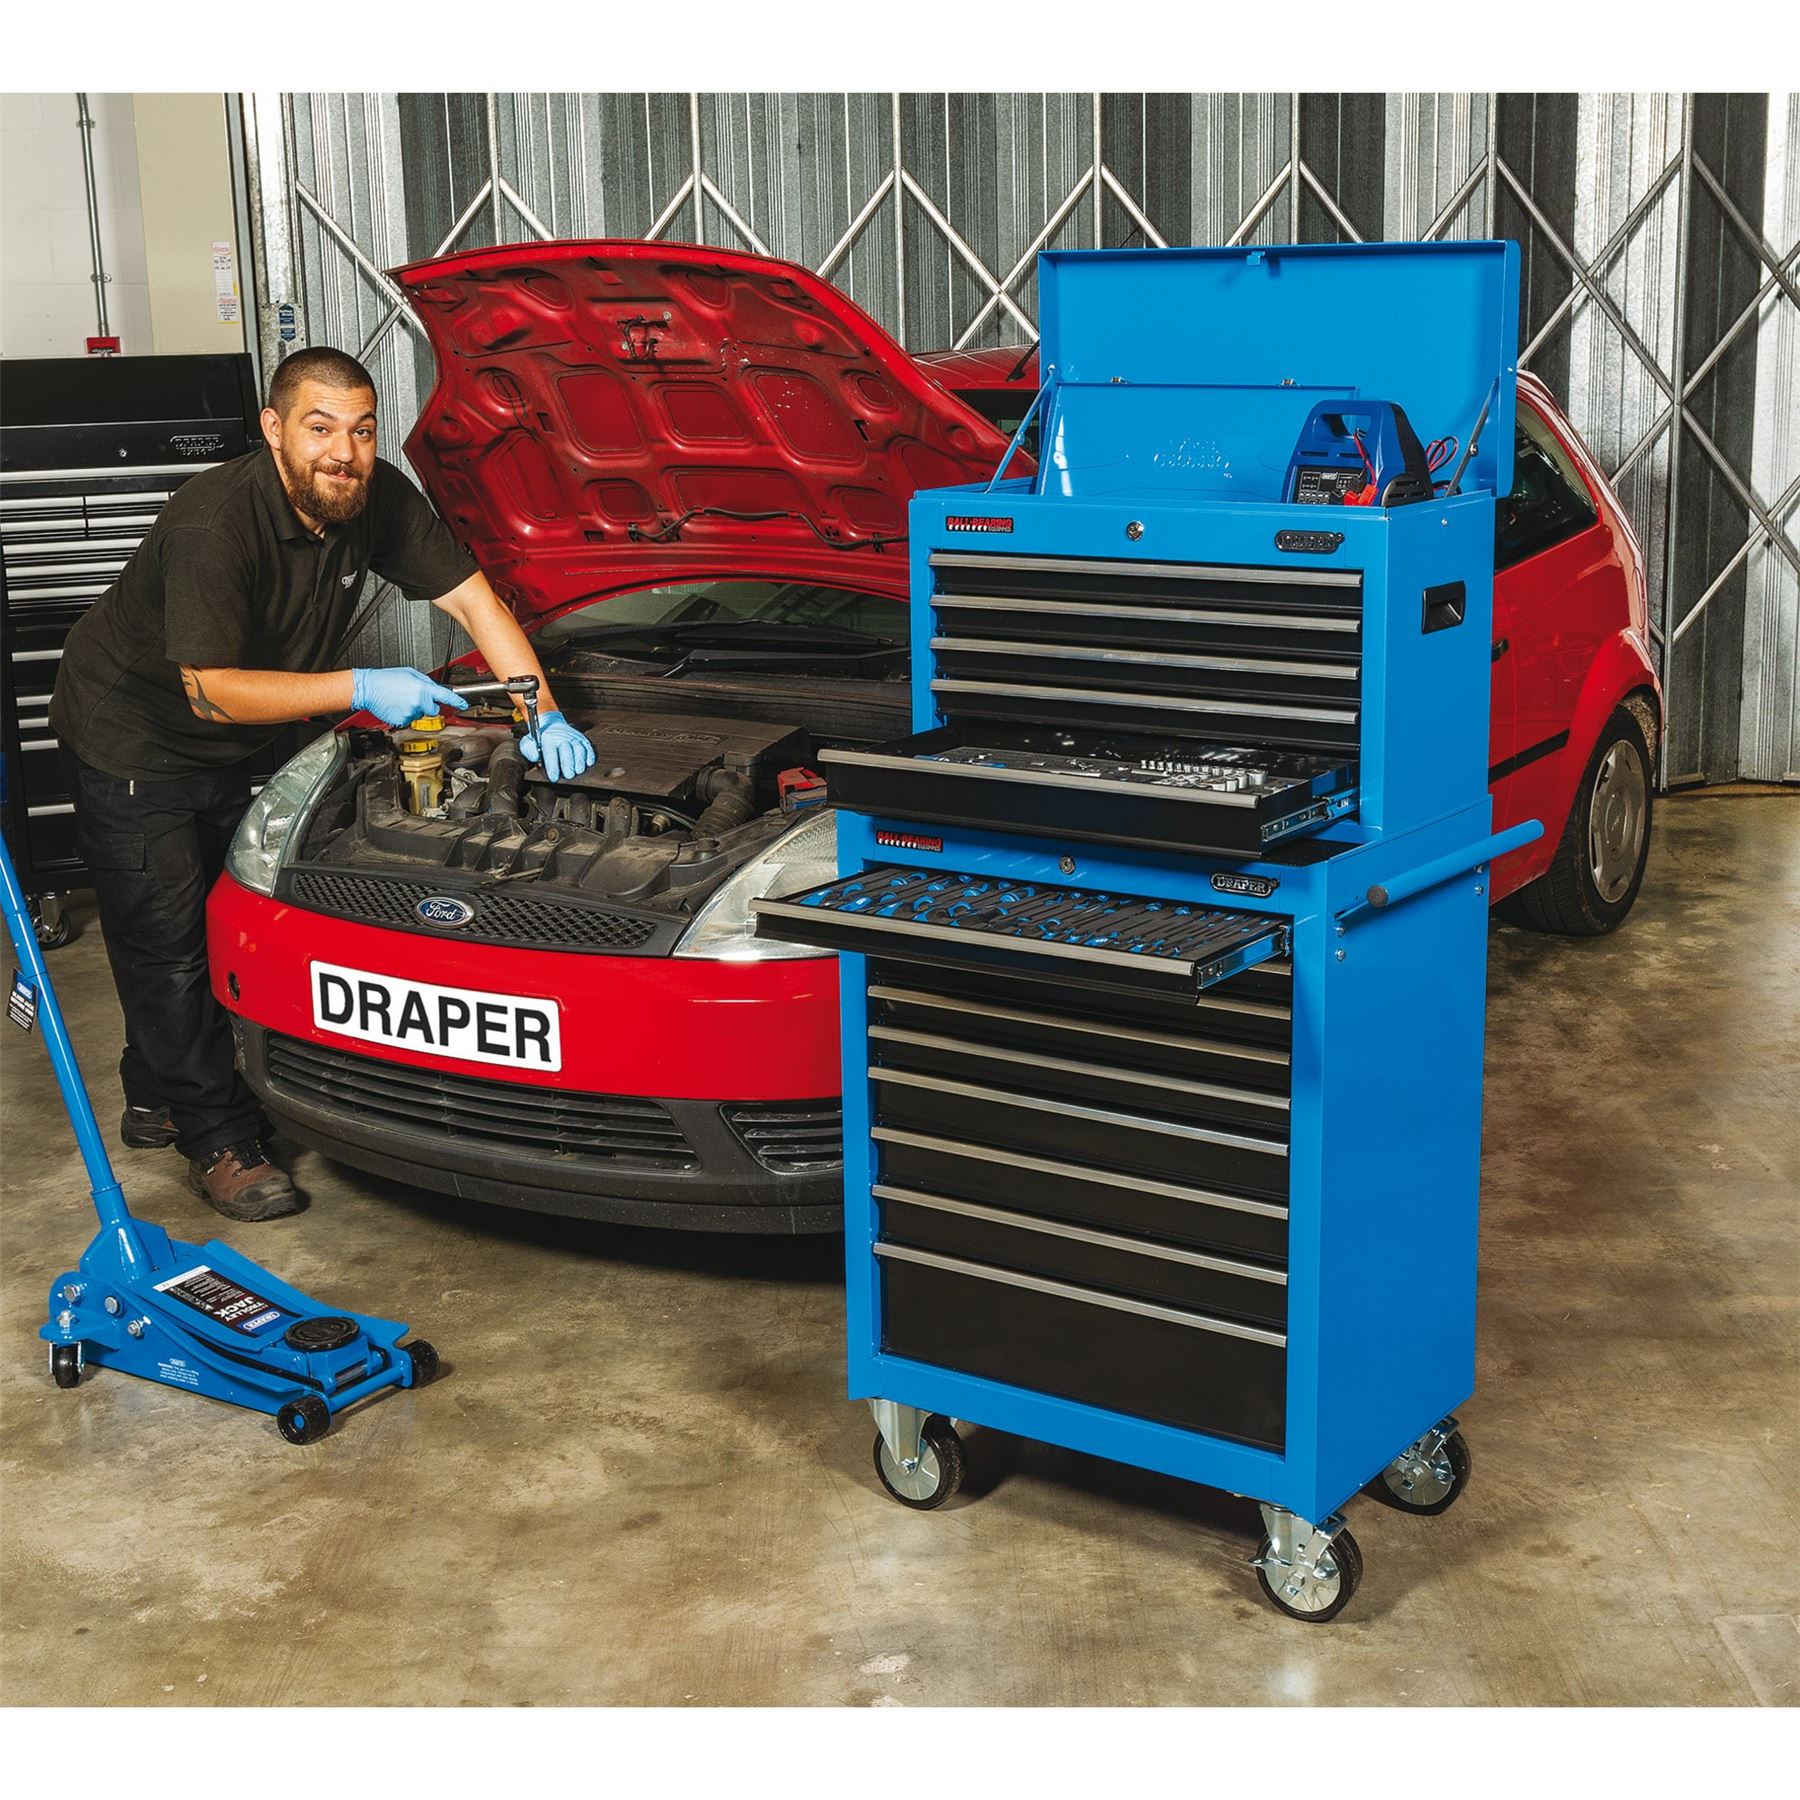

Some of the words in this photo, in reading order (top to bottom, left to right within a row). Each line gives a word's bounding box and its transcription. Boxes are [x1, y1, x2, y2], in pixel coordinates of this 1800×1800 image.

[1216, 876, 1266, 893] DRAPER
[425, 901, 458, 920] Ford
[319, 972, 552, 1063] DRAPER
[213, 1296, 254, 1318] JACK
[225, 1301, 265, 1321] TROLLEY
